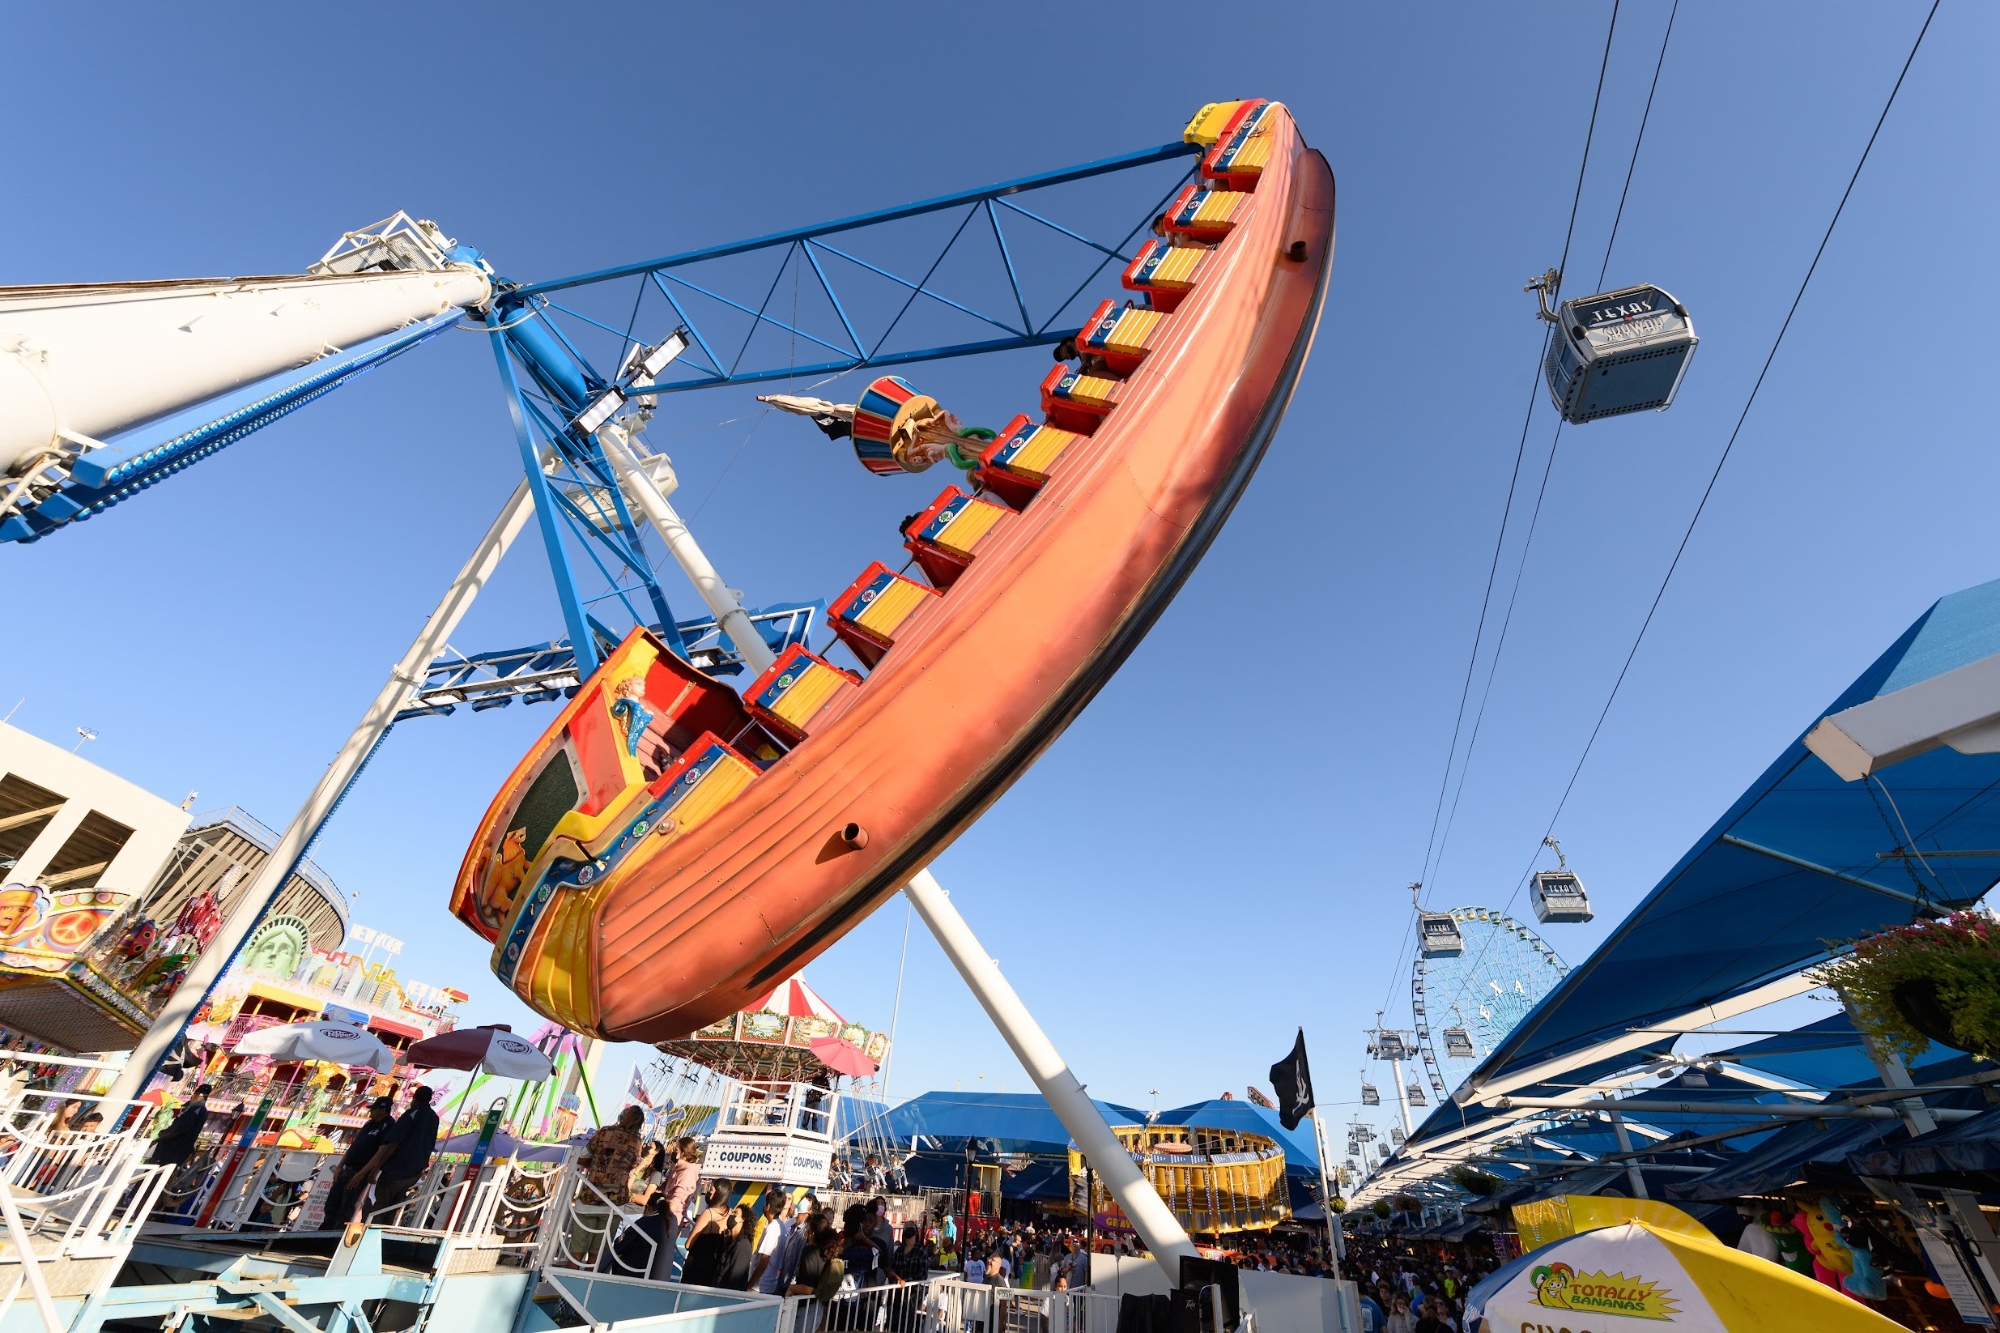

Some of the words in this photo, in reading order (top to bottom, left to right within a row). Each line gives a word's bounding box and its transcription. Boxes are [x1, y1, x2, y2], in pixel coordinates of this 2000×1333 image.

[1592, 300, 1652, 321] TEXAS
[1603, 316, 1664, 341] SKYWAY
[348, 923, 378, 944] NEW
[374, 931, 405, 955] YORK
[1680, 1103, 1690, 1112] A2
[720, 1151, 772, 1164] COUPONS
[793, 1156, 823, 1170] COUPONS
[1105, 1217, 1131, 1229] GRAV
[1569, 1283, 1652, 1302] TOTALLY
[1570, 1295, 1646, 1312] BANANAS
